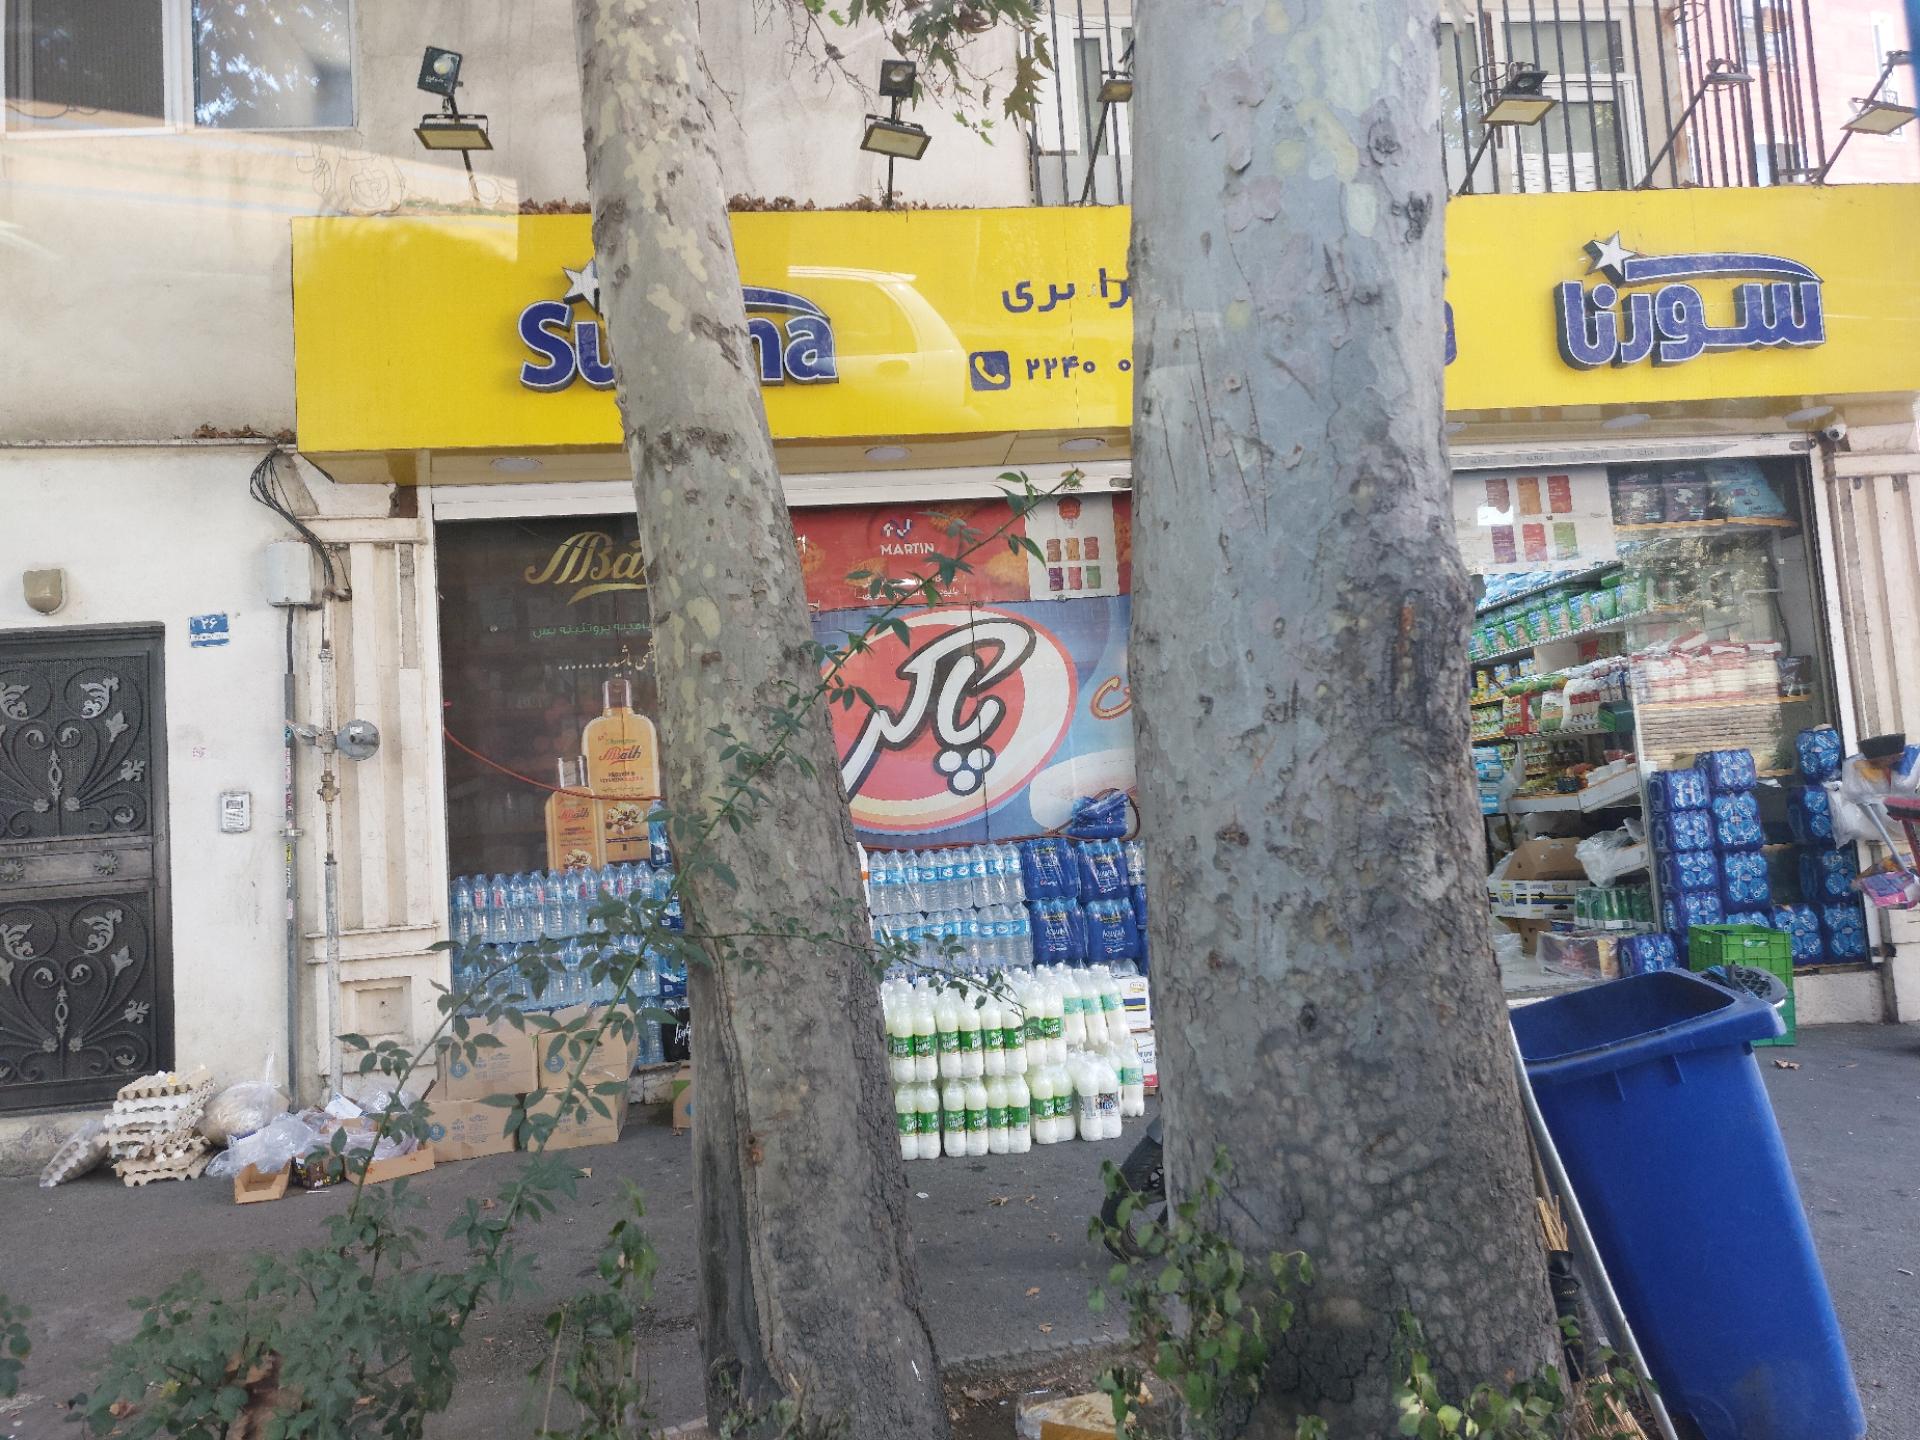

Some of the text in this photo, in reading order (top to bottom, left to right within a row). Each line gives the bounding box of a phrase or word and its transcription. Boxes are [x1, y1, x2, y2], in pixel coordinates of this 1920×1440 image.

[519, 299, 839, 392] Suna
[1554, 279, 1826, 371] سورنا
[880, 542, 935, 556] MARTIN
